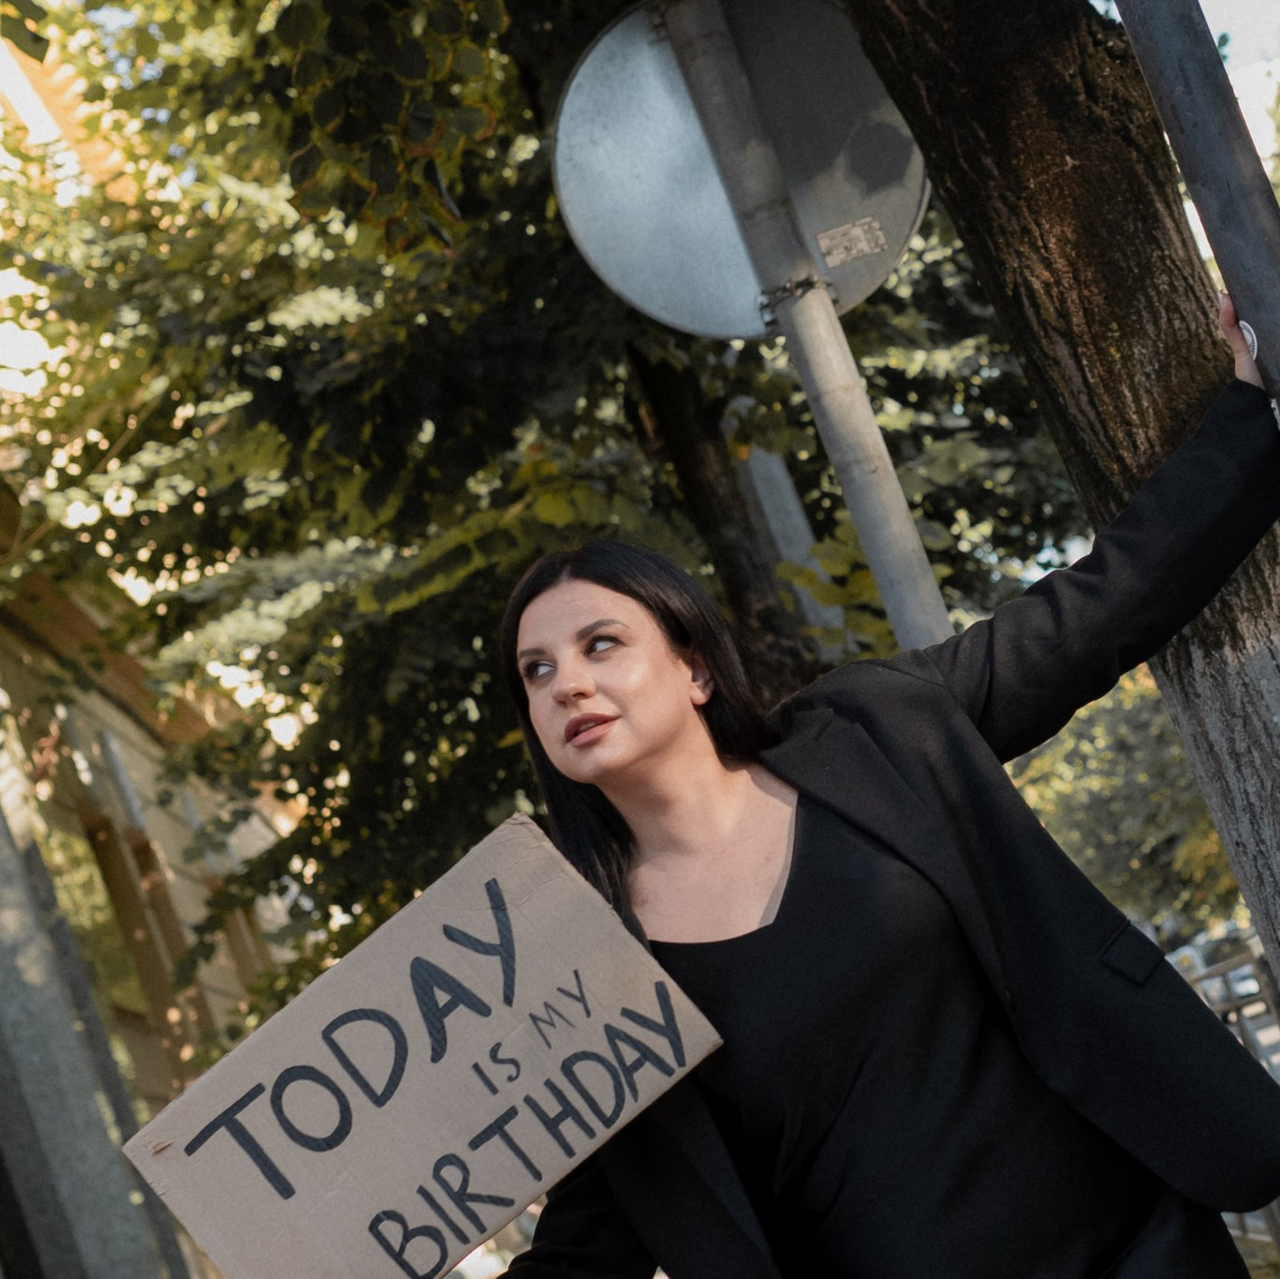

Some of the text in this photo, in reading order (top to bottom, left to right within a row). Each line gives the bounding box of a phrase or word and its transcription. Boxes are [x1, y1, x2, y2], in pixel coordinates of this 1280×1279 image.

[183, 877, 516, 1200] TODAY
[471, 968, 592, 1096] IS MY
